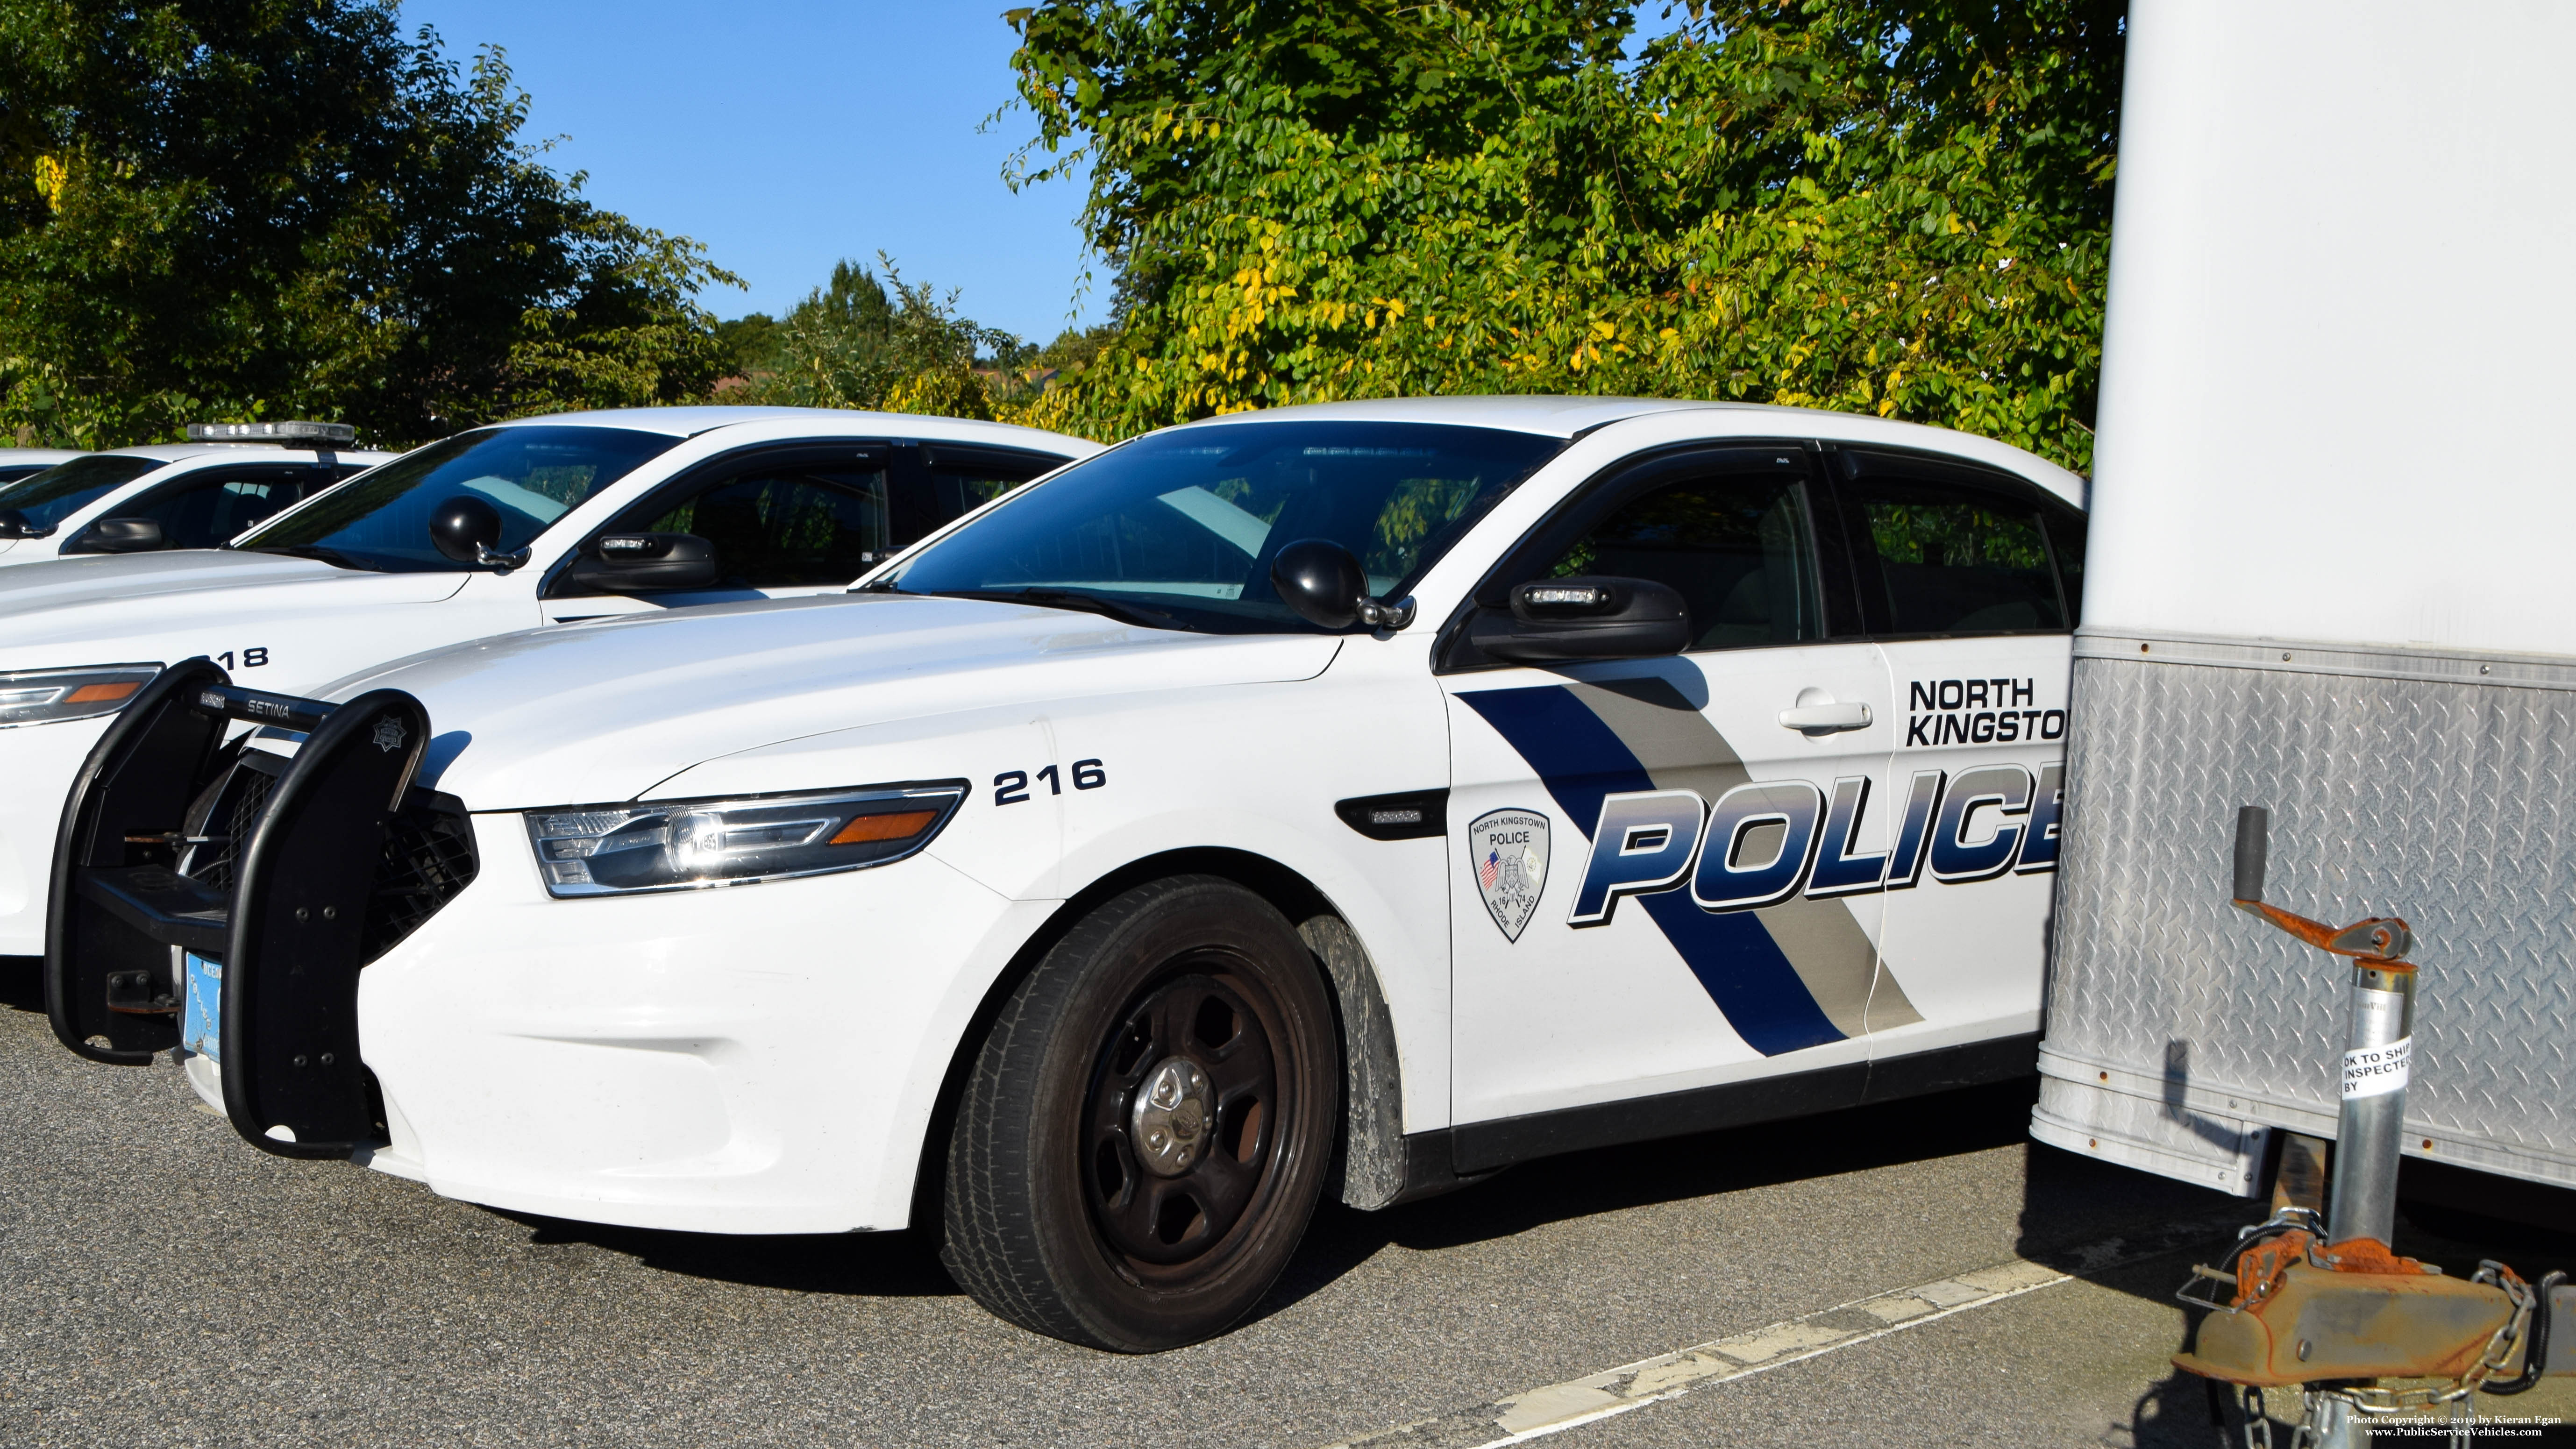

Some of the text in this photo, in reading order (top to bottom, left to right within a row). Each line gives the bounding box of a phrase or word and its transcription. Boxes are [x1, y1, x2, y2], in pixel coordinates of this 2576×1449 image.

[188, 647, 269, 671] 18
[1909, 678, 2034, 711] NORTH
[248, 699, 290, 719] SETINA
[1906, 709, 2071, 747] KINGSTO
[993, 758, 1107, 807] 216
[1473, 817, 1546, 835] NORTH KINGSTOWN
[1489, 831, 1530, 845] POLICE
[1566, 760, 2067, 930] POLICE
[1499, 894, 1526, 905] 16 74
[1490, 899, 1510, 929] RHODE
[1515, 895, 1535, 929] ISLAND
[2344, 1043, 2410, 1067] OK TO SHIP
[2344, 1081, 2357, 1092] BY
